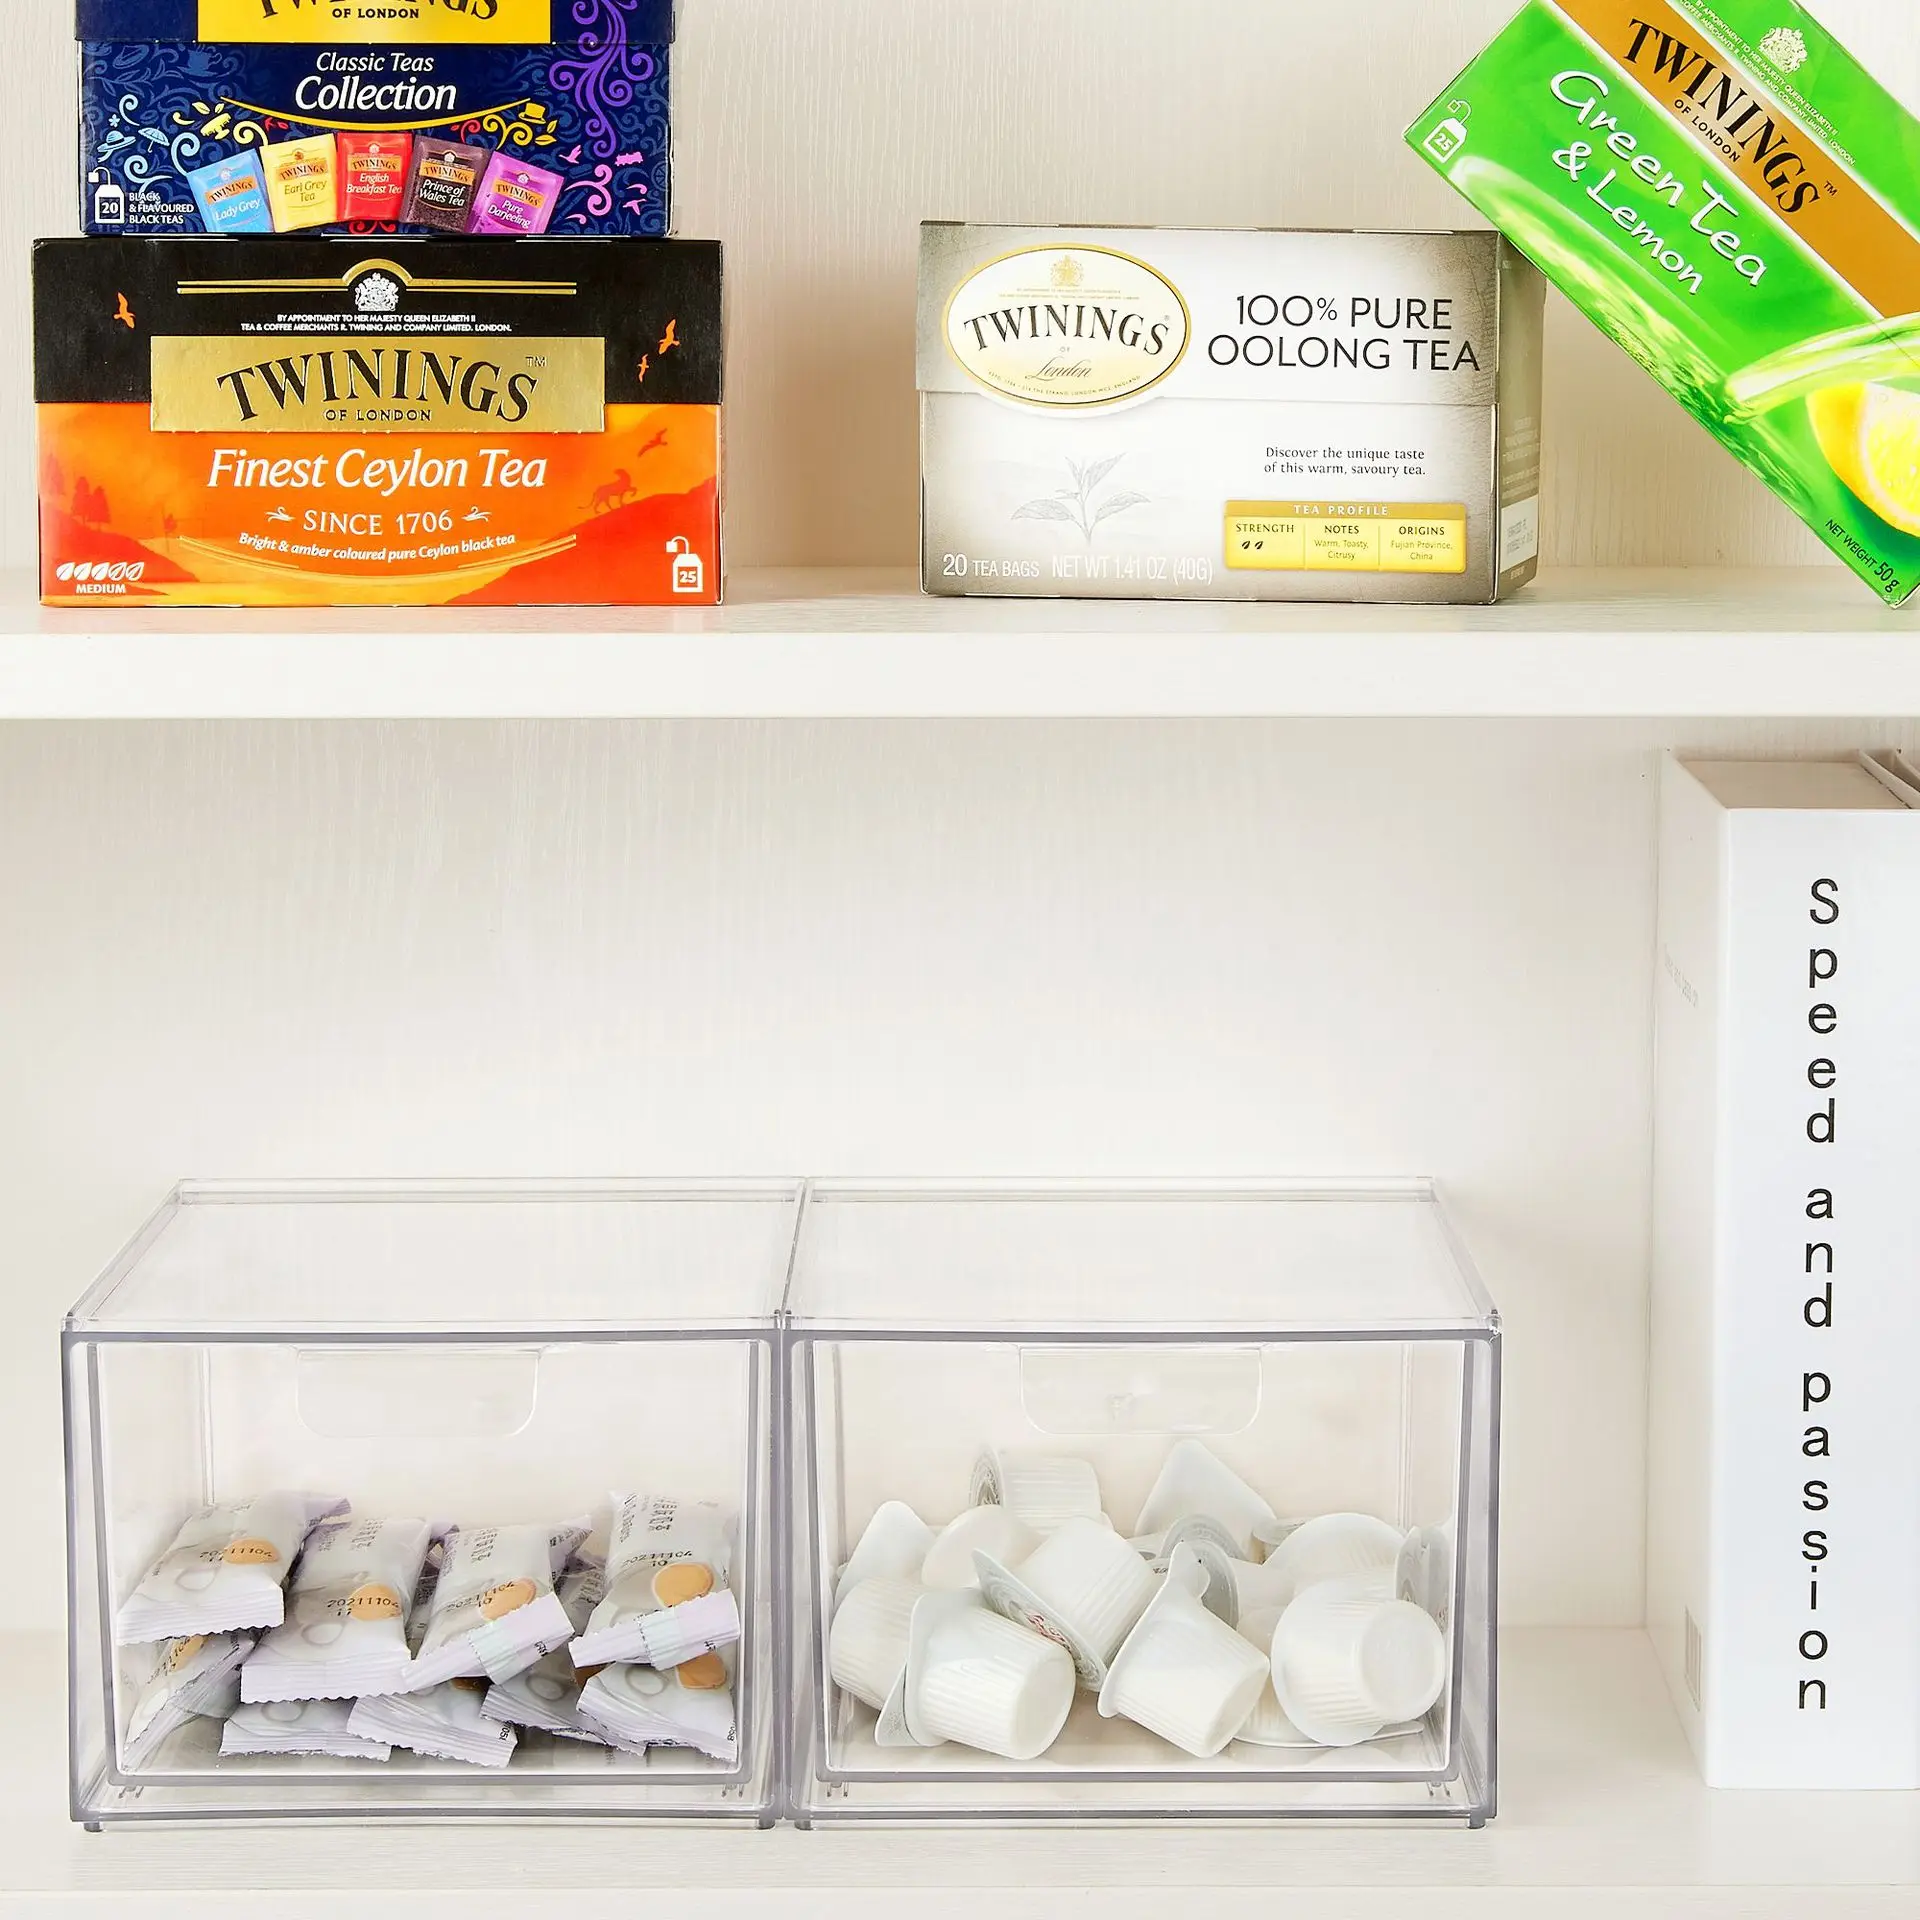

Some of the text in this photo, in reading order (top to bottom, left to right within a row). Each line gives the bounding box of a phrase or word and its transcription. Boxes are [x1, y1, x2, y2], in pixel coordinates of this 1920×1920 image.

[332, 8, 351, 18] OF
[358, 8, 419, 19] LONDON
[316, 51, 435, 72] Classic Teas
[1701, 16, 1735, 53] MERCHANTS
[1740, 51, 1765, 81] TWINING
[1764, 76, 1779, 94] AND
[1777, 89, 1806, 121] COMPANY
[1703, 8, 1743, 44] APPOINTMENT
[1741, 42, 1751, 53] TO
[1750, 48, 1762, 62] HER
[1761, 58, 1785, 86] MAJESTY
[1784, 84, 1805, 107] QUEEN
[1804, 100, 1834, 132] ELIZABETH
[295, 76, 457, 110] Collection
[1624, 18, 1820, 213] TWININGS
[1674, 99, 1741, 163] OF LONDON
[1434, 133, 1454, 151] 25
[280, 164, 325, 180] TWININGS
[352, 159, 397, 170] TWININGS
[359, 173, 389, 184] English
[424, 165, 469, 182] TWININGS
[1550, 70, 1768, 286] Green Tea
[209, 180, 254, 202] TWININGS
[284, 180, 327, 195] Earl Grey
[346, 184, 402, 195] Breakfast Tea
[422, 179, 466, 198] Prince of
[495, 183, 541, 206] TWININGS
[129, 192, 161, 202] BLACK
[300, 192, 316, 202] Tea
[419, 188, 466, 207] Wales Tea
[101, 202, 119, 214] 20
[129, 203, 194, 213] & FLAVOURED
[214, 198, 262, 221] Lady Grey
[502, 200, 524, 213] Pure
[129, 215, 184, 224] BLACK TEAS
[487, 204, 531, 229] Darjeeling
[1552, 141, 1703, 294] & Lemon
[277, 314, 287, 322] BY
[287, 314, 341, 322] APPOINTMENT
[342, 314, 353, 322] TO
[1237, 294, 1452, 330] 100% PURE
[241, 323, 256, 331] TEA
[256, 323, 263, 331] &
[263, 323, 292, 331] COFFEE
[293, 323, 339, 332] MERCHANTS
[348, 324, 383, 332] TWINING
[384, 324, 402, 332] AND
[403, 324, 442, 332] COMPANY
[443, 324, 474, 332] LIMITED.
[475, 324, 512, 332] LONDON.
[964, 304, 1169, 356] TWININGS
[1208, 334, 1480, 371] OOLONG TEA
[1025, 356, 1093, 382] London
[216, 349, 537, 423] TWININGS
[324, 409, 432, 422] OF LONDON
[1266, 446, 1425, 463] Discover the unique taste
[207, 447, 548, 497] Finest Ceylon Tea
[1264, 461, 1426, 478] of this warm, savoury tea.
[1294, 504, 1389, 516] TEA PROFILE
[303, 509, 453, 536] SINCE 1706
[1236, 523, 1295, 534] STRENGTH
[1324, 525, 1360, 535] NOTES
[1398, 526, 1445, 536] ORIGINS
[239, 532, 515, 563] Bright & amber coloured pure Ceylon black tea
[1314, 539, 1369, 551] Warm, Toasty,
[1390, 540, 1453, 551] Fujian Province,
[1327, 551, 1356, 561] Citrusy
[1410, 552, 1433, 561] China
[1825, 519, 1900, 593] NET WEIGHT 50 g
[679, 570, 697, 584] 25
[943, 553, 1214, 586] 20 TEA BAGS NET WT 1.41 OZ (40G)
[76, 583, 126, 594] MEDIUM
[1798, 877, 1840, 1710] Speed and passion
